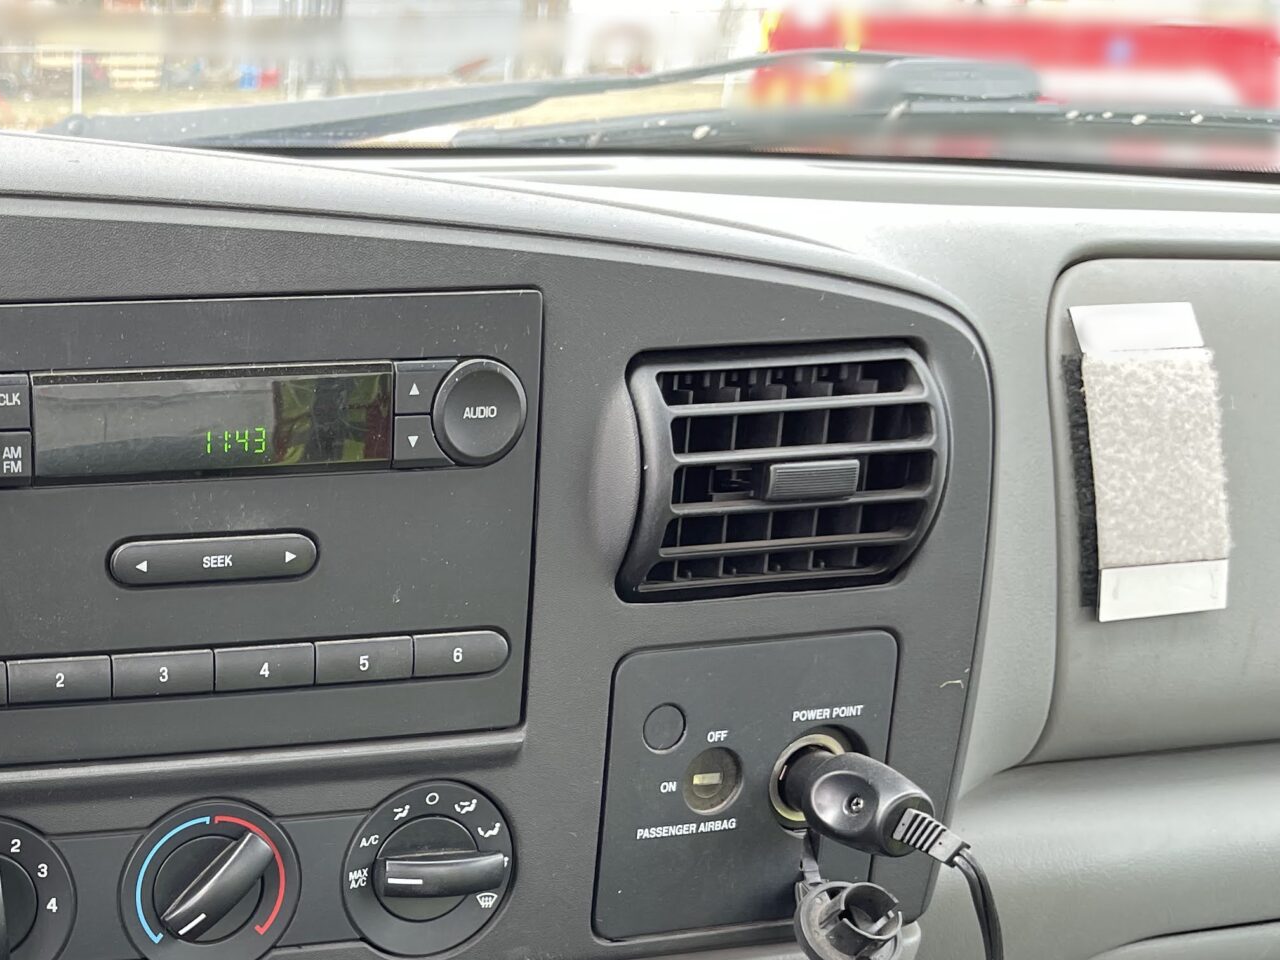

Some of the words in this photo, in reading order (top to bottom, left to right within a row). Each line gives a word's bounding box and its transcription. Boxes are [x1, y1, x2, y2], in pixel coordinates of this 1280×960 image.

[463, 405, 497, 419] AUDIO
[207, 426, 266, 455] 11:43
[3, 446, 22, 459] AM
[3, 461, 22, 474] FM
[202, 554, 233, 570] SEEK
[358, 655, 369, 671] 5
[452, 647, 463, 664] 6
[158, 667, 169, 683] 3
[259, 662, 270, 678] 4
[55, 672, 65, 689] 2
[792, 708, 830, 721] POWER
[832, 705, 864, 719] POINT
[707, 730, 728, 742] OFF
[660, 781, 677, 793] ON
[636, 822, 697, 840] PASSENGER
[698, 818, 737, 833] AIRBAG
[10, 839, 21, 853] 2
[359, 834, 379, 848] A/C
[37, 864, 48, 878] 3
[348, 867, 369, 882] MAX
[349, 877, 367, 890] A/C
[46, 897, 58, 913] 4
